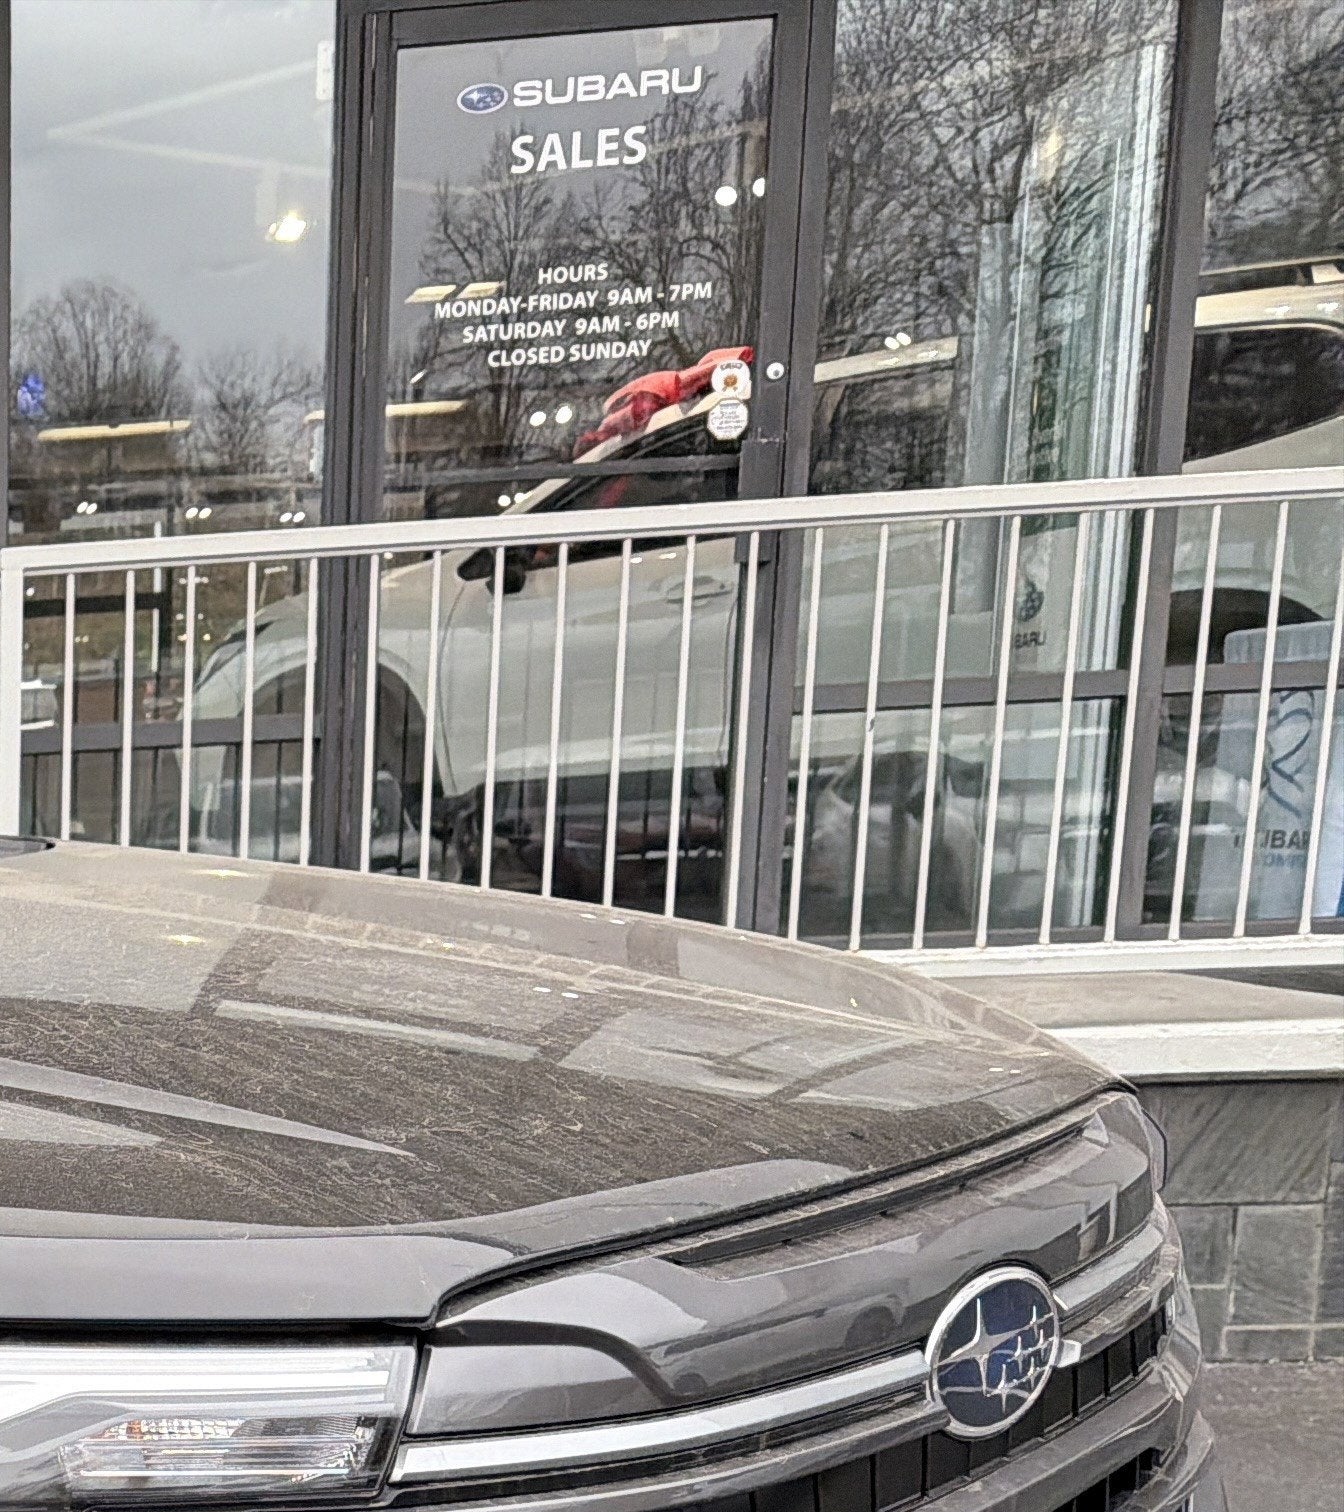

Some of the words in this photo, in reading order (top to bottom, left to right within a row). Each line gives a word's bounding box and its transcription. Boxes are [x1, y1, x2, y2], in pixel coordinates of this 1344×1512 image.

[512, 65, 703, 107] SUBARU
[510, 125, 648, 174] SALES
[538, 262, 609, 285] HOURS
[434, 290, 599, 319] MONDAY-FRIDAY
[607, 287, 653, 307] 9AM
[668, 281, 712, 302] 7PM
[462, 319, 567, 344] SATURDAY
[574, 314, 620, 335] 9AM
[636, 310, 680, 331] 6PM
[487, 345, 566, 368] CLOSED
[568, 339, 653, 362] SUNDAY
